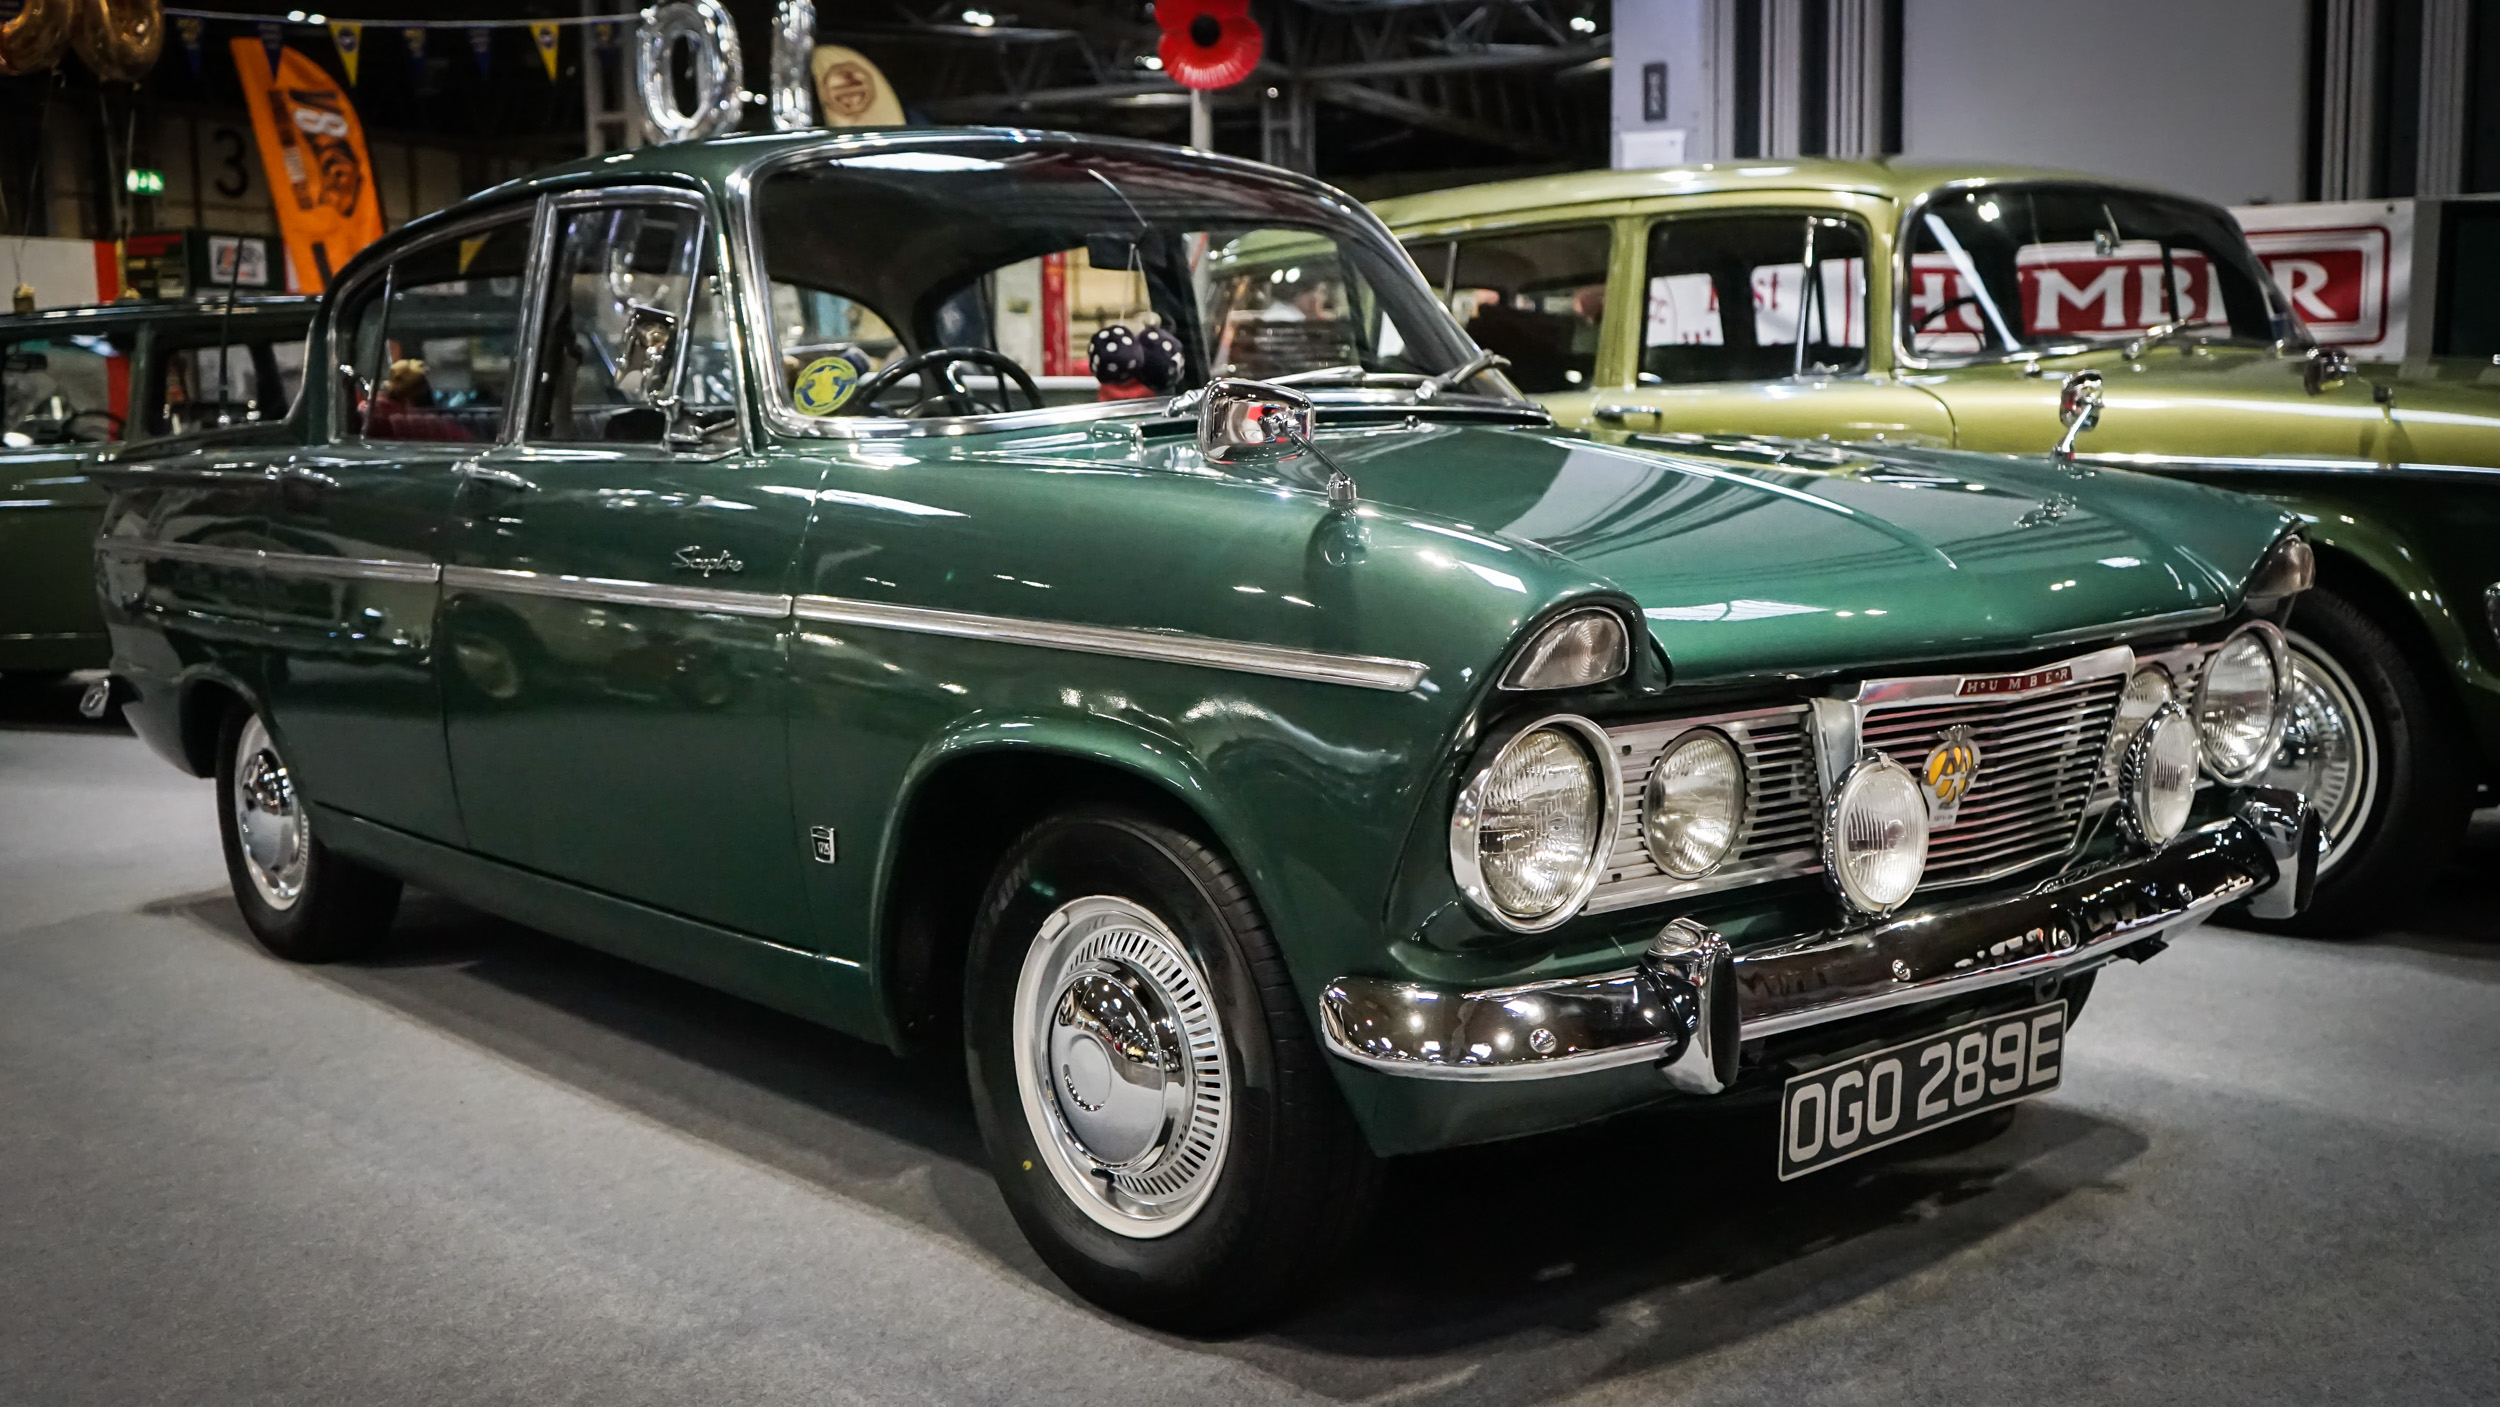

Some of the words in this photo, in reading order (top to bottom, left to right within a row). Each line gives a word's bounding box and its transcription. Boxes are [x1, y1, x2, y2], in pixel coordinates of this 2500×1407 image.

[213, 127, 249, 198] 3
[1966, 667, 2069, 693] HUMBER
[1789, 1058, 1903, 1163] OGO
[1917, 1010, 2063, 1121] 289E
